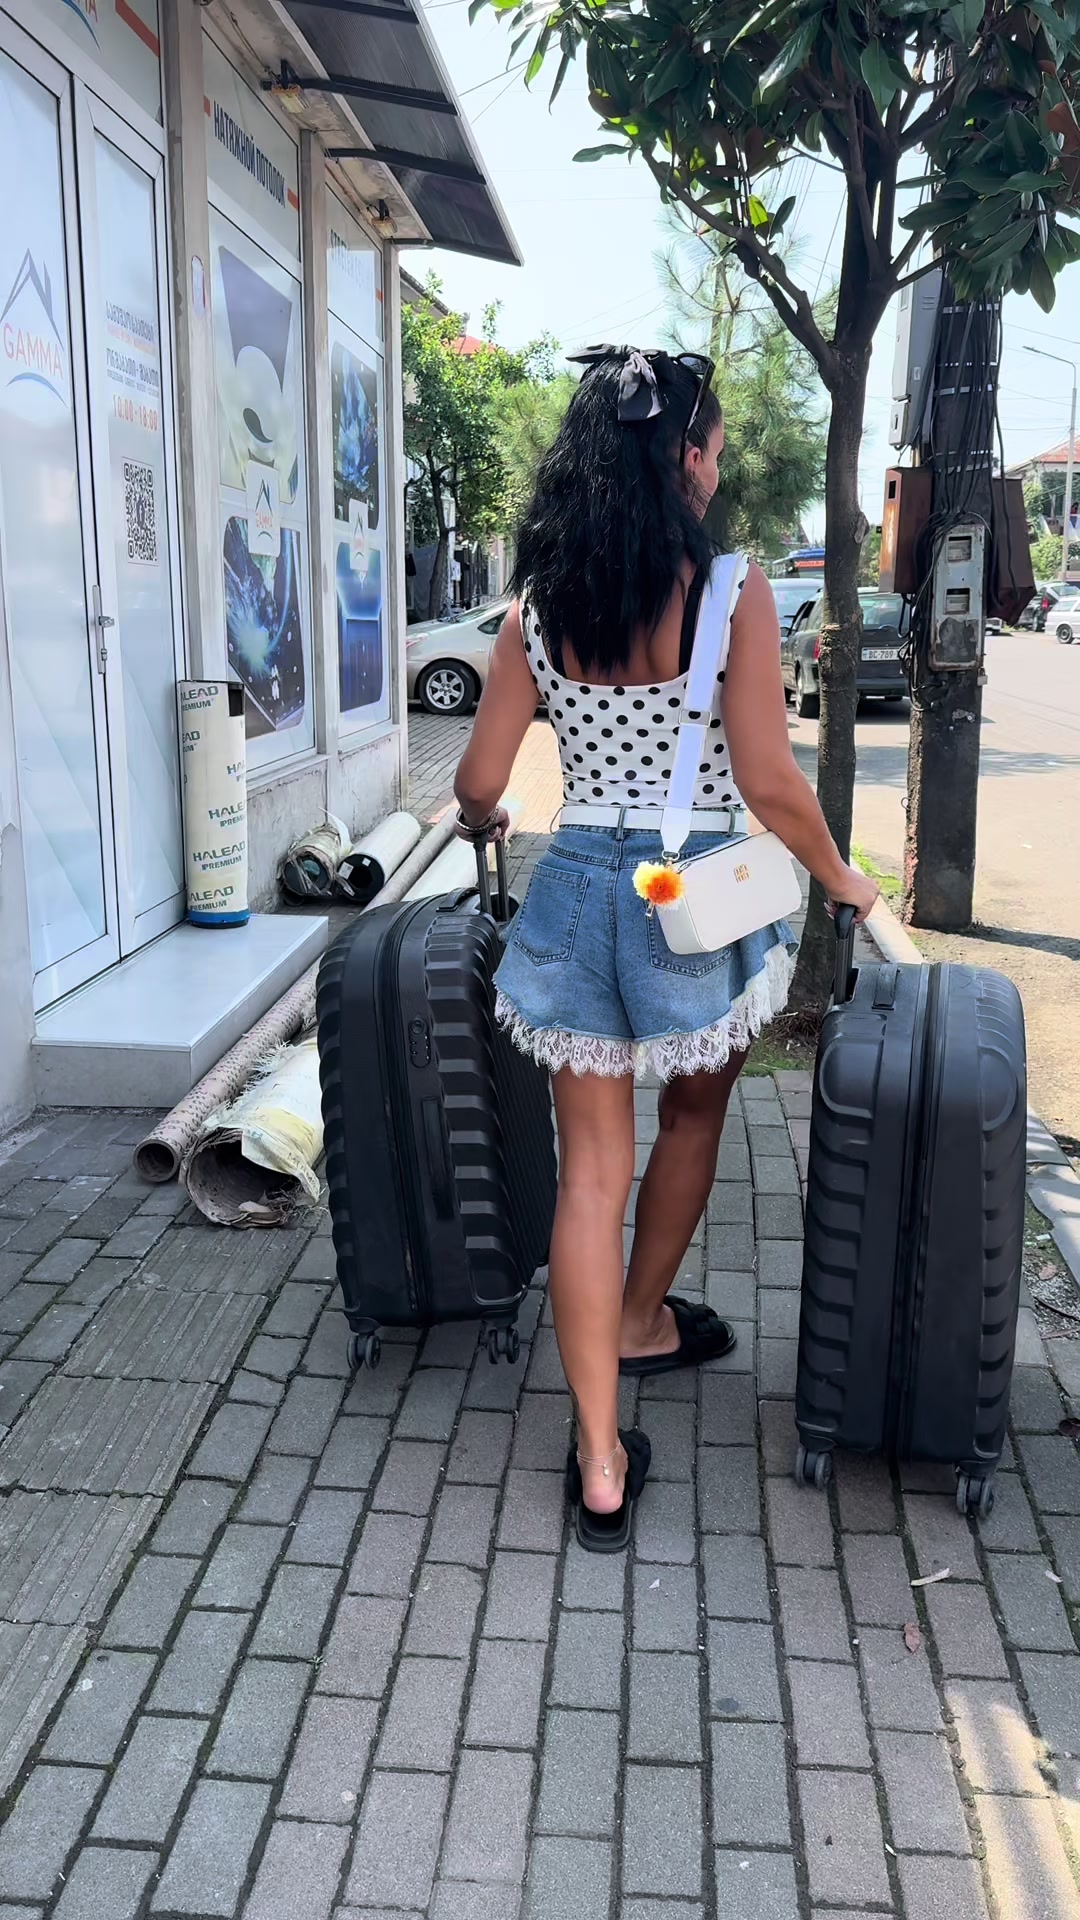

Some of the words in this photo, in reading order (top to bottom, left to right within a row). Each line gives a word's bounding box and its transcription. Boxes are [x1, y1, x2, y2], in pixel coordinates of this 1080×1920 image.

[213, 99, 256, 177] НАТЯЖНОЙ
[256, 147, 286, 208] ПОТОЛОК
[3, 322, 64, 380] GAMMA
[192, 841, 246, 862] HALEAD
[202, 855, 242, 871] PREMIUM
